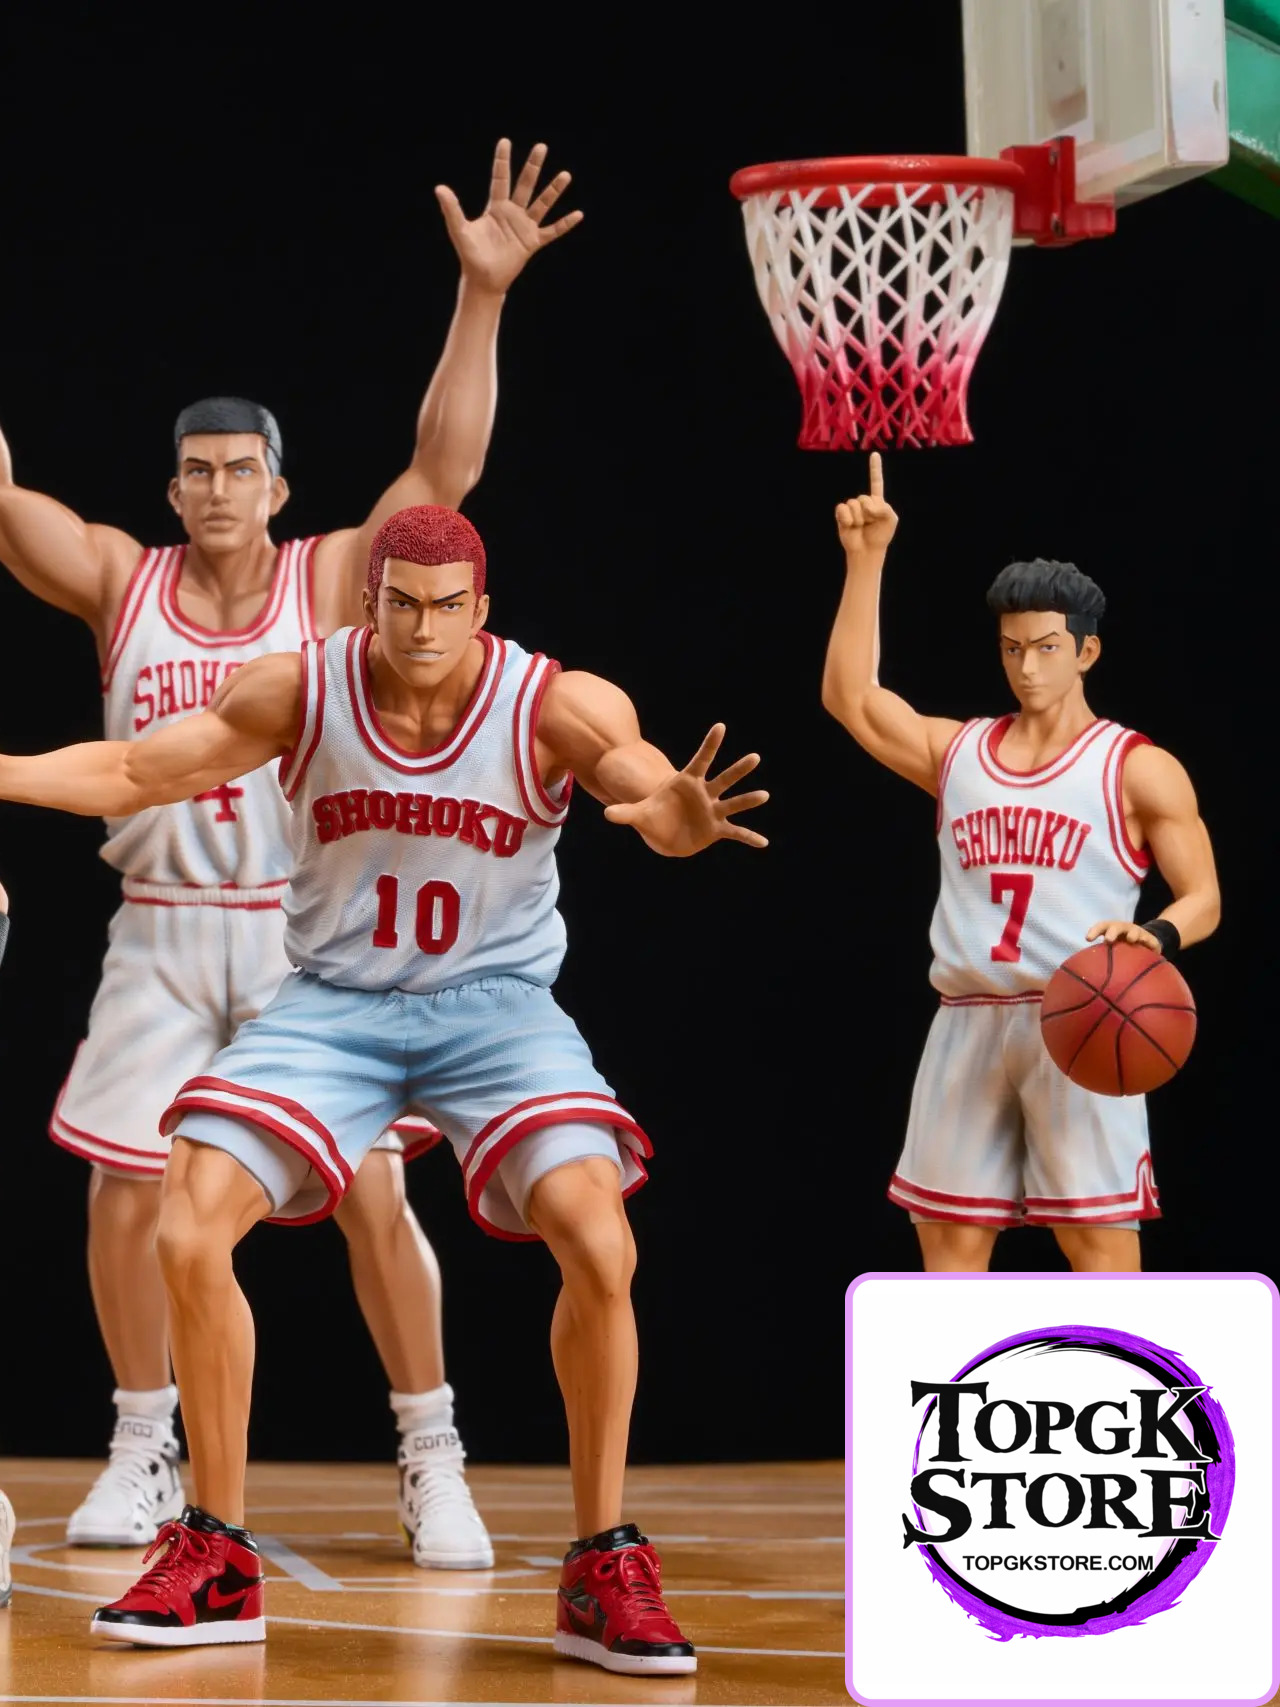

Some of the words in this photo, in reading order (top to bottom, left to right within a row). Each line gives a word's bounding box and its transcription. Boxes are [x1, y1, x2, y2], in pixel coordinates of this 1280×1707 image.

[132, 658, 245, 733] SHOH
[312, 788, 529, 858] SHOHOKU
[950, 805, 1092, 872] SHOHOKU
[372, 873, 461, 956] 10
[989, 872, 1034, 963] 7
